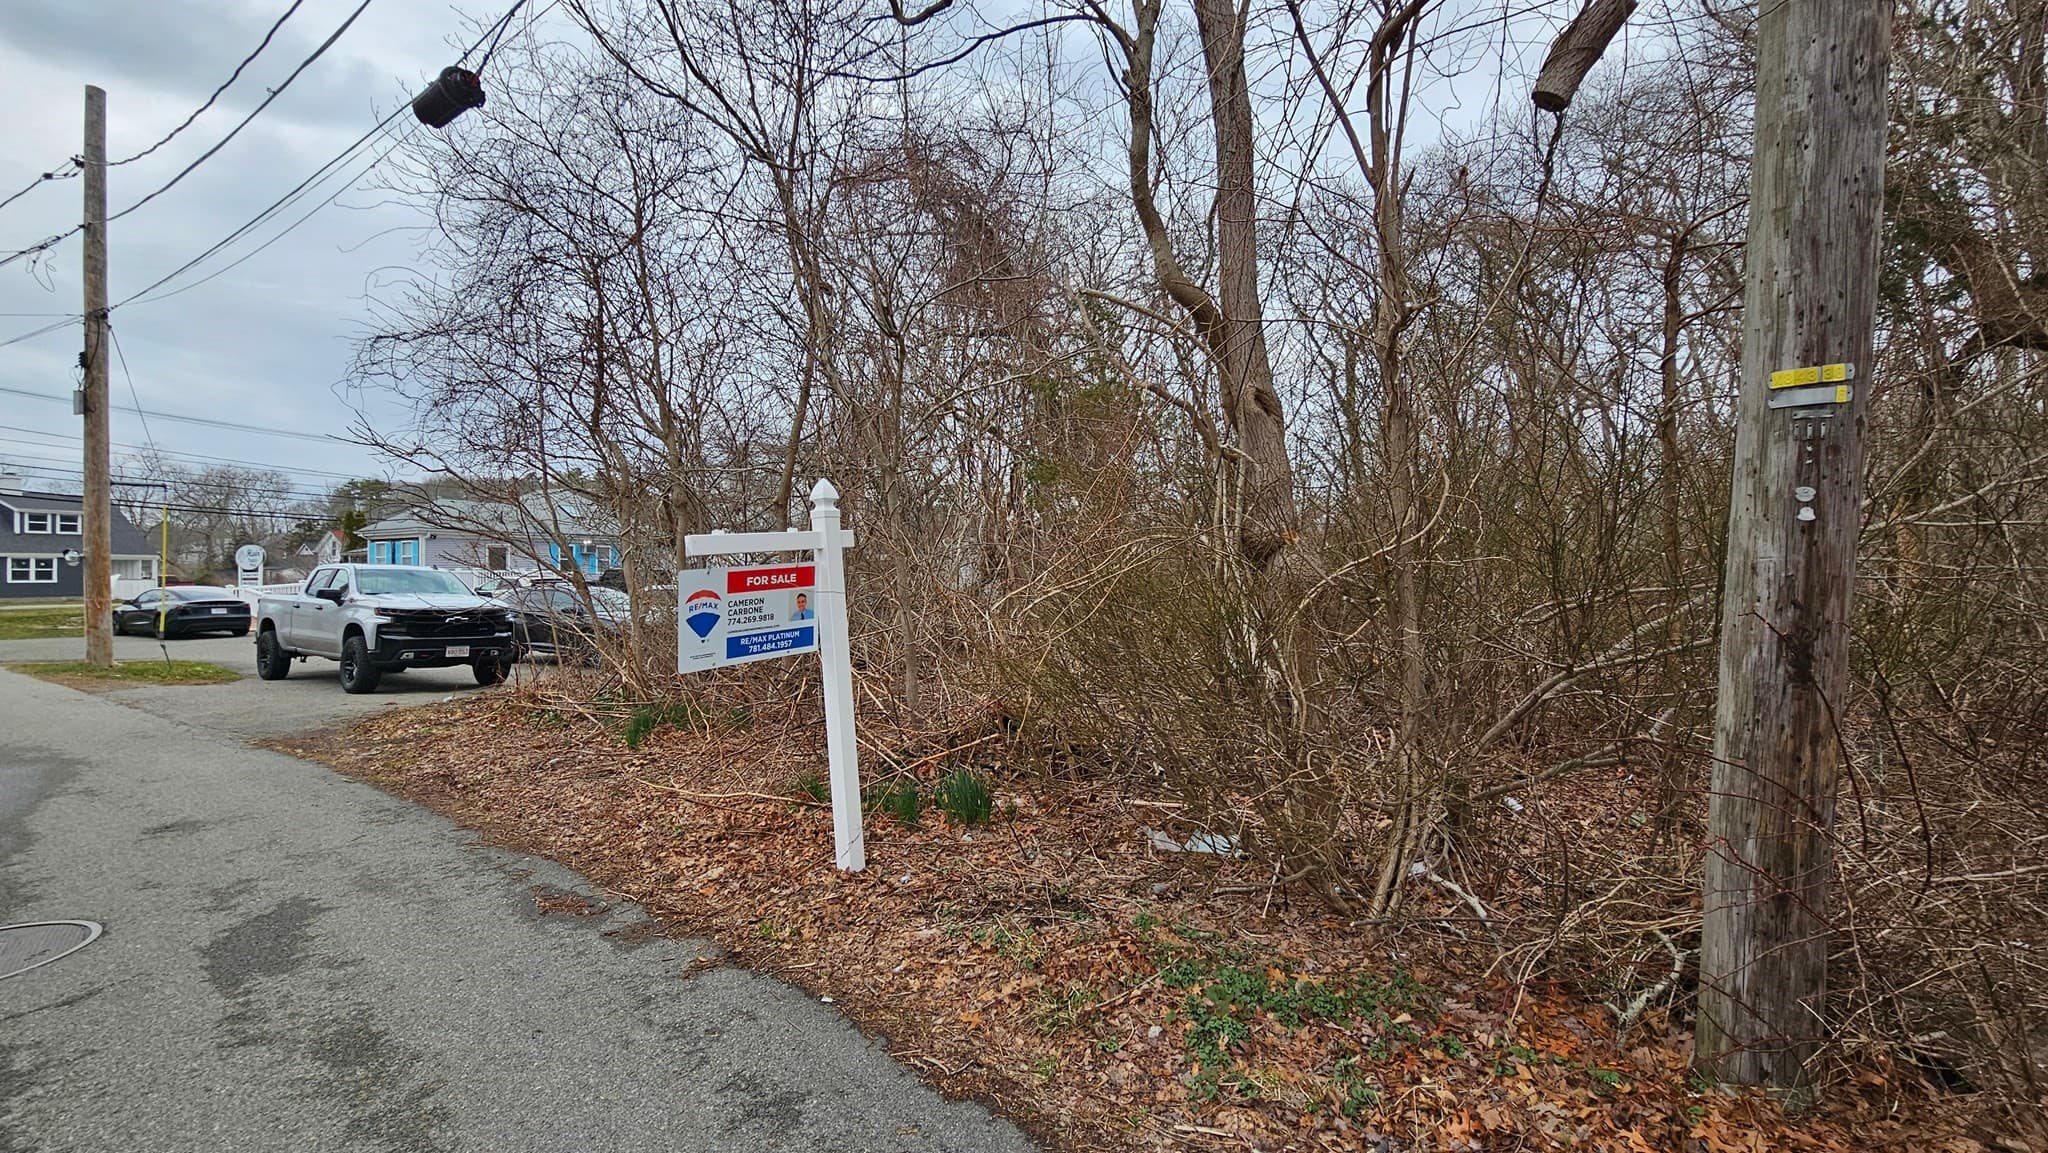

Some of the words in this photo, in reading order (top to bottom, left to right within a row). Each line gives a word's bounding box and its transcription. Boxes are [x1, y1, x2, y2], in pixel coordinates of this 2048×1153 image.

[746, 576, 769, 586] FOR
[770, 574, 797, 584] SALE
[689, 603, 718, 613] RE/MAX
[728, 598, 765, 608] CAMERON
[728, 606, 764, 617] CARBONE
[728, 614, 775, 626] 774.269.9818
[740, 635, 767, 645] RE/MAX
[768, 631, 800, 642] PLATINUM
[749, 640, 793, 653] 781.484.1957
